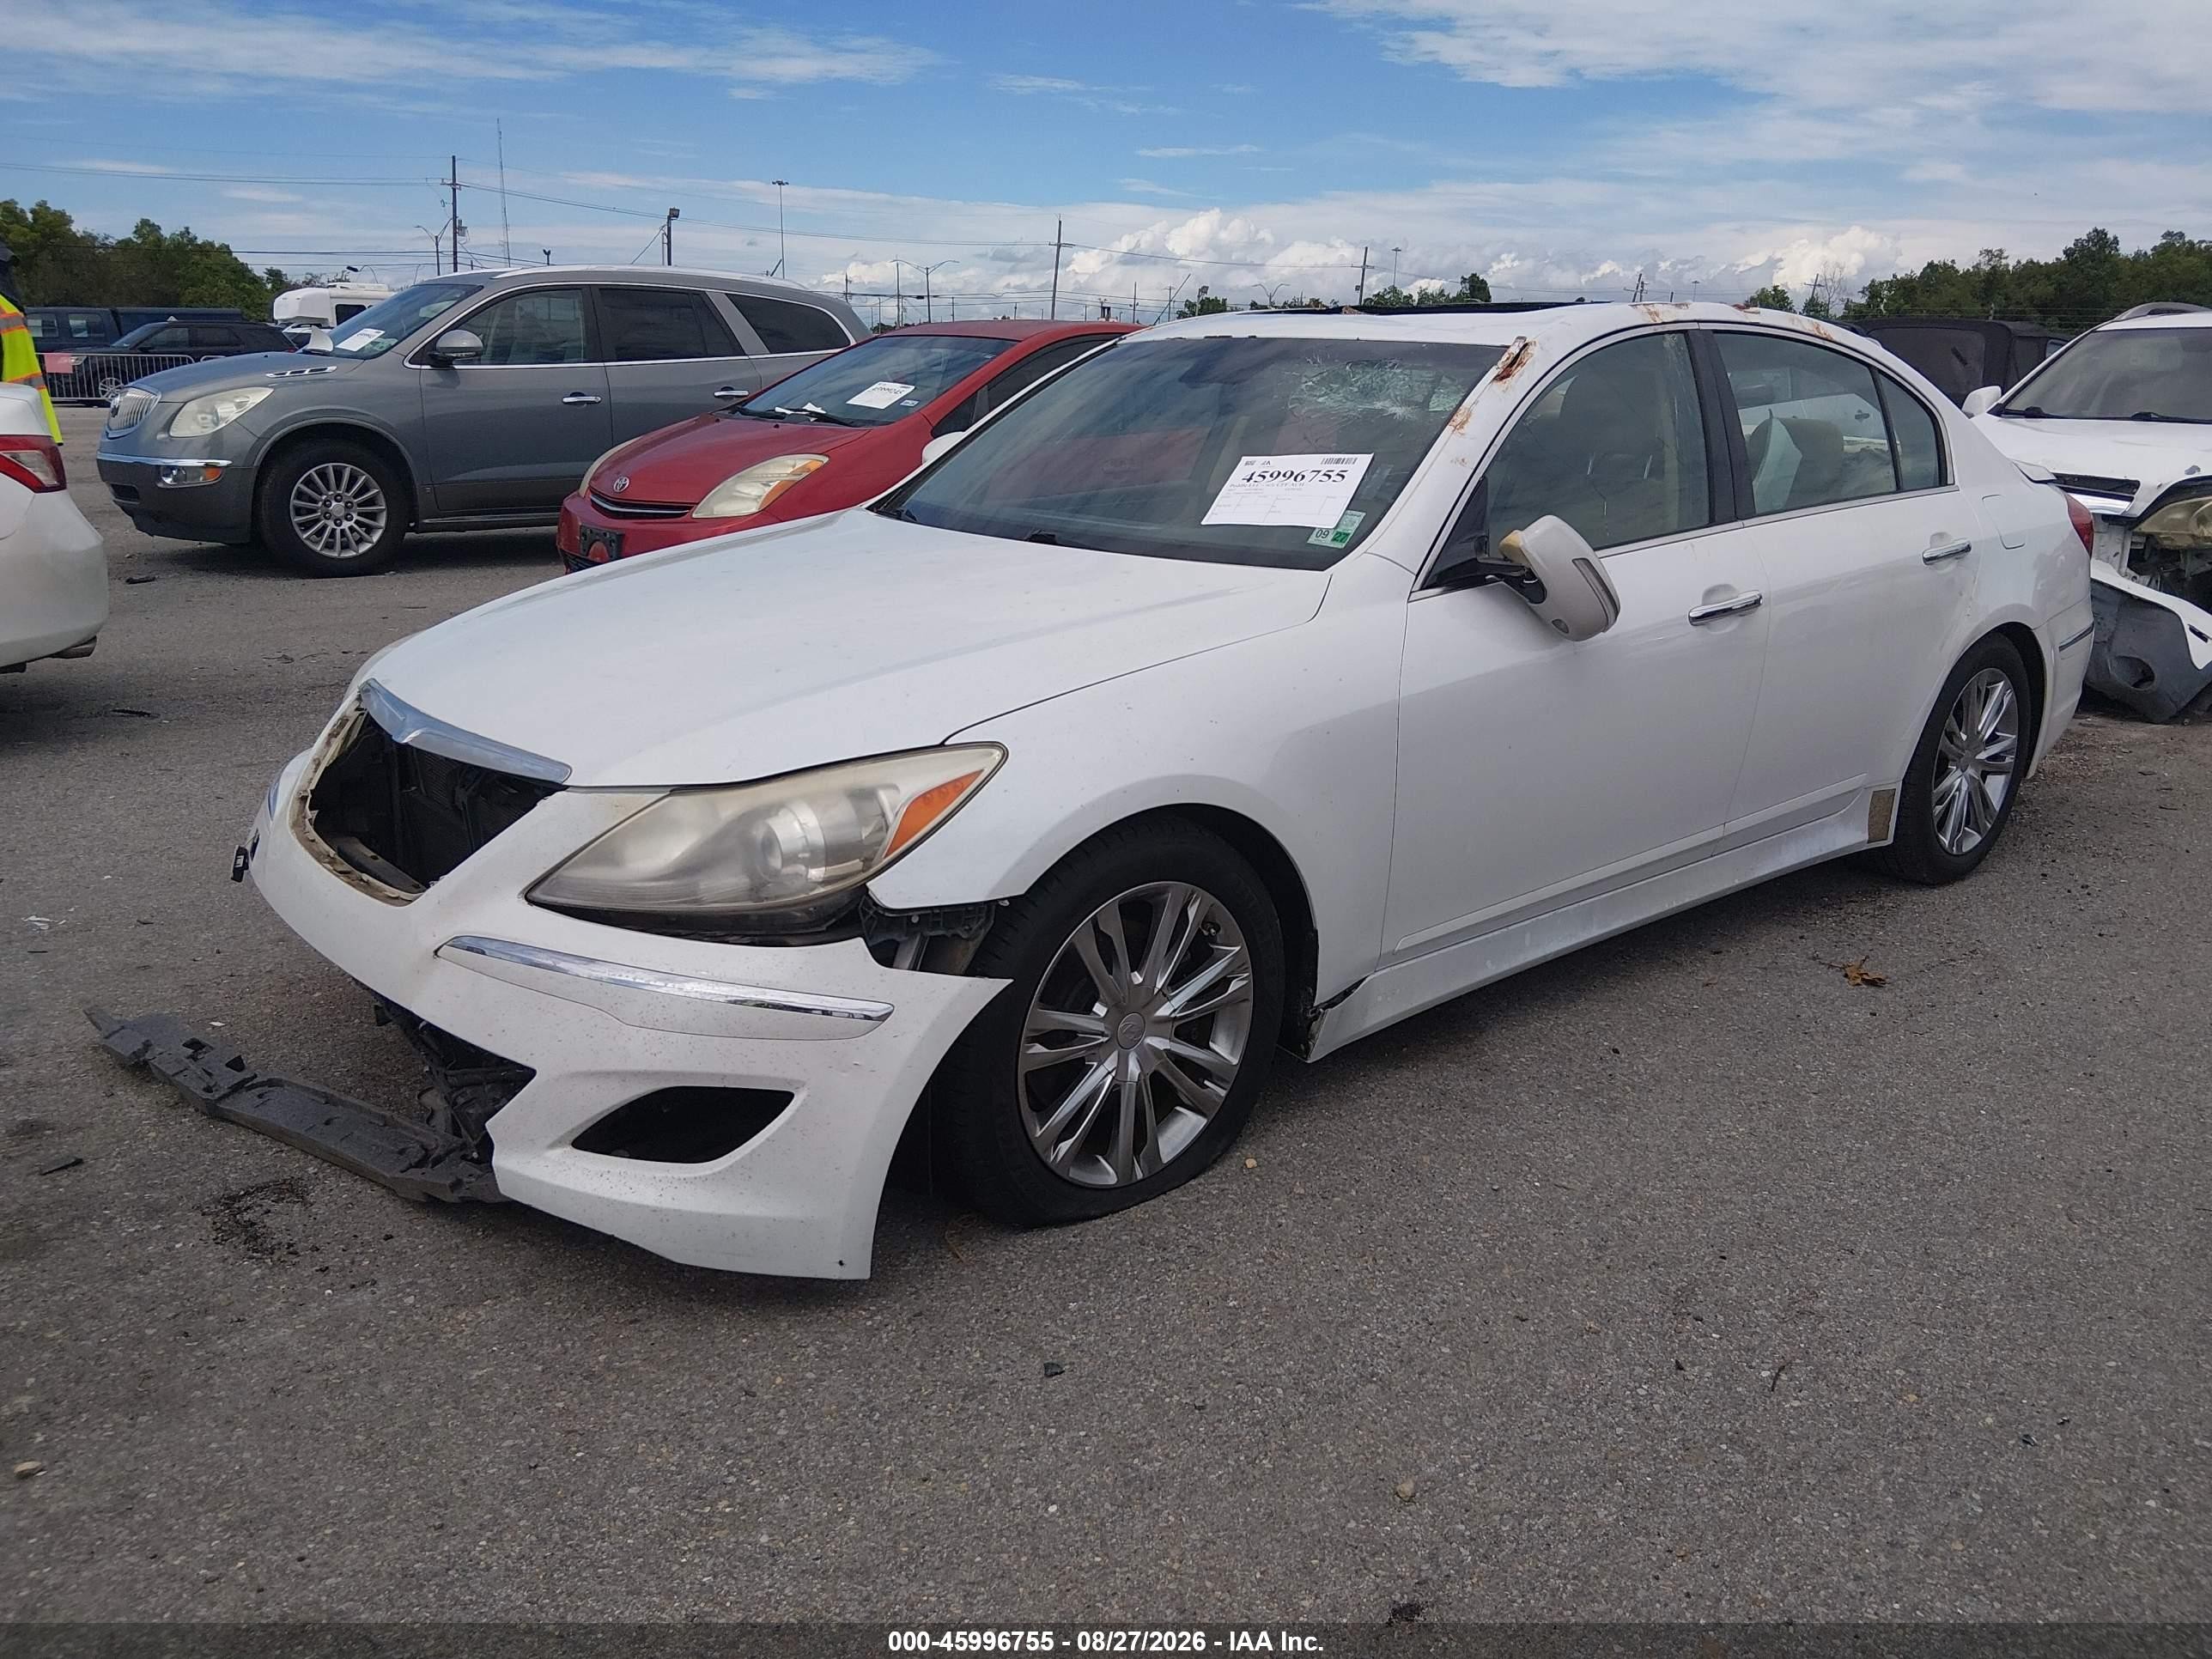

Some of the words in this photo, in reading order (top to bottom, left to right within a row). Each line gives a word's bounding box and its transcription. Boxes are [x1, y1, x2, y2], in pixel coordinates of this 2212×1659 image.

[1242, 469, 1348, 483] 45996755
[1315, 529, 1330, 539] 09
[1332, 531, 1350, 543] 27
